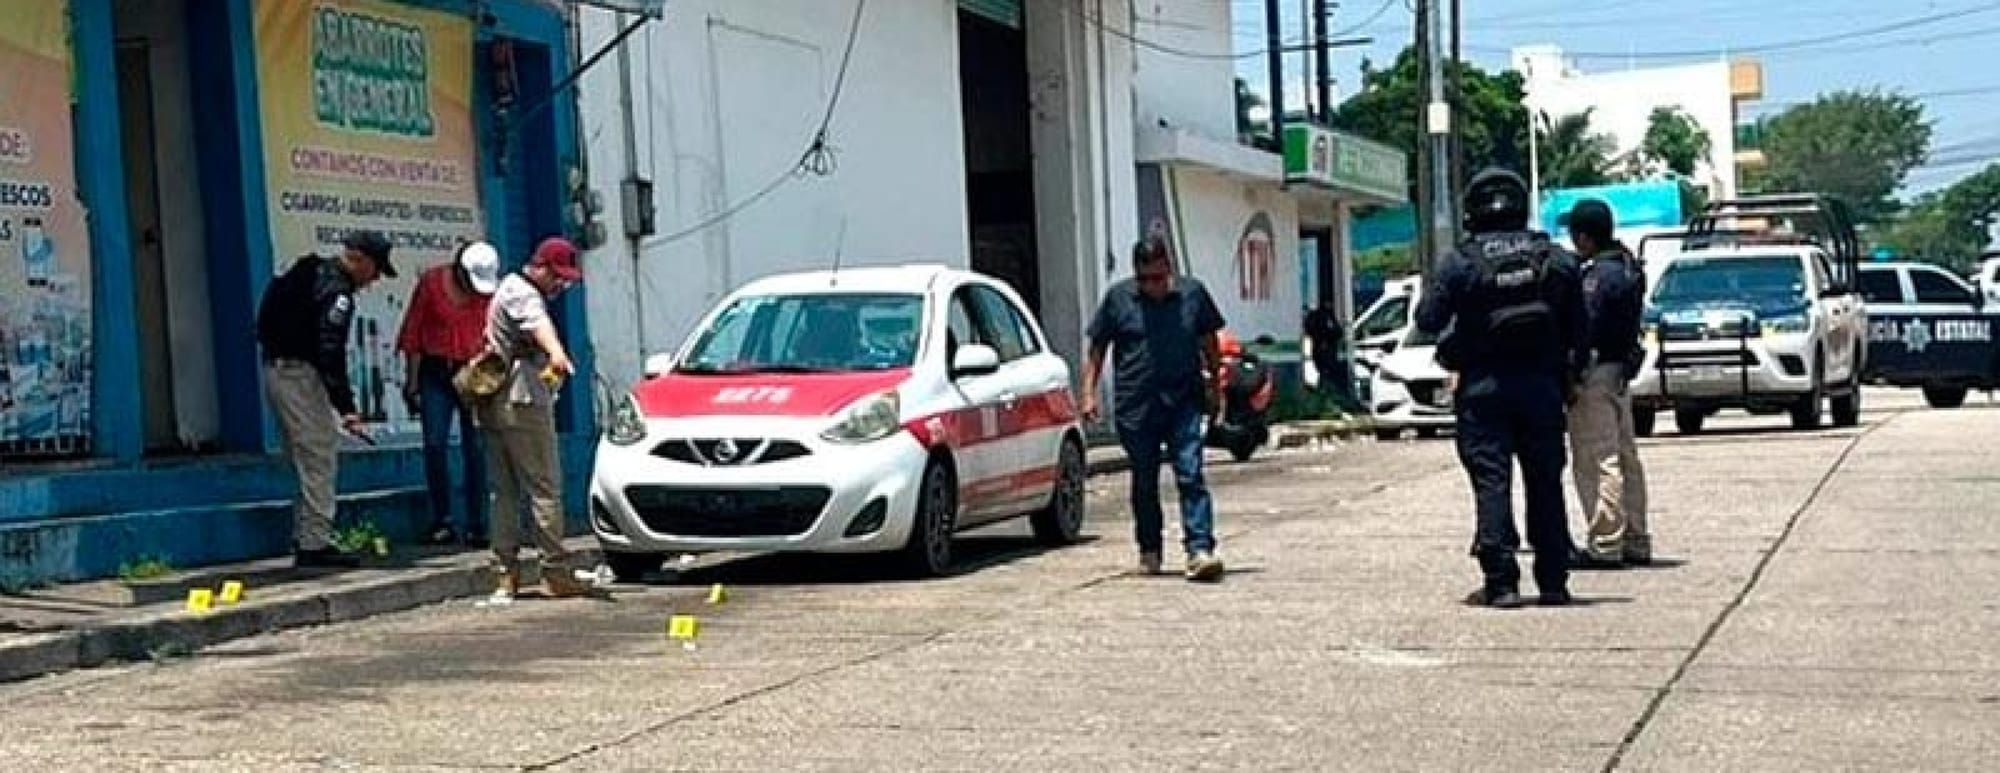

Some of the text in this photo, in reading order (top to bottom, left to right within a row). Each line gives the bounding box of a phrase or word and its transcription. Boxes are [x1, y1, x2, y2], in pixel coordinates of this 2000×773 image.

[313, 11, 425, 74] ABARROTES
[314, 68, 432, 132] EN GENERAL
[0, 182, 52, 207] ESCOS
